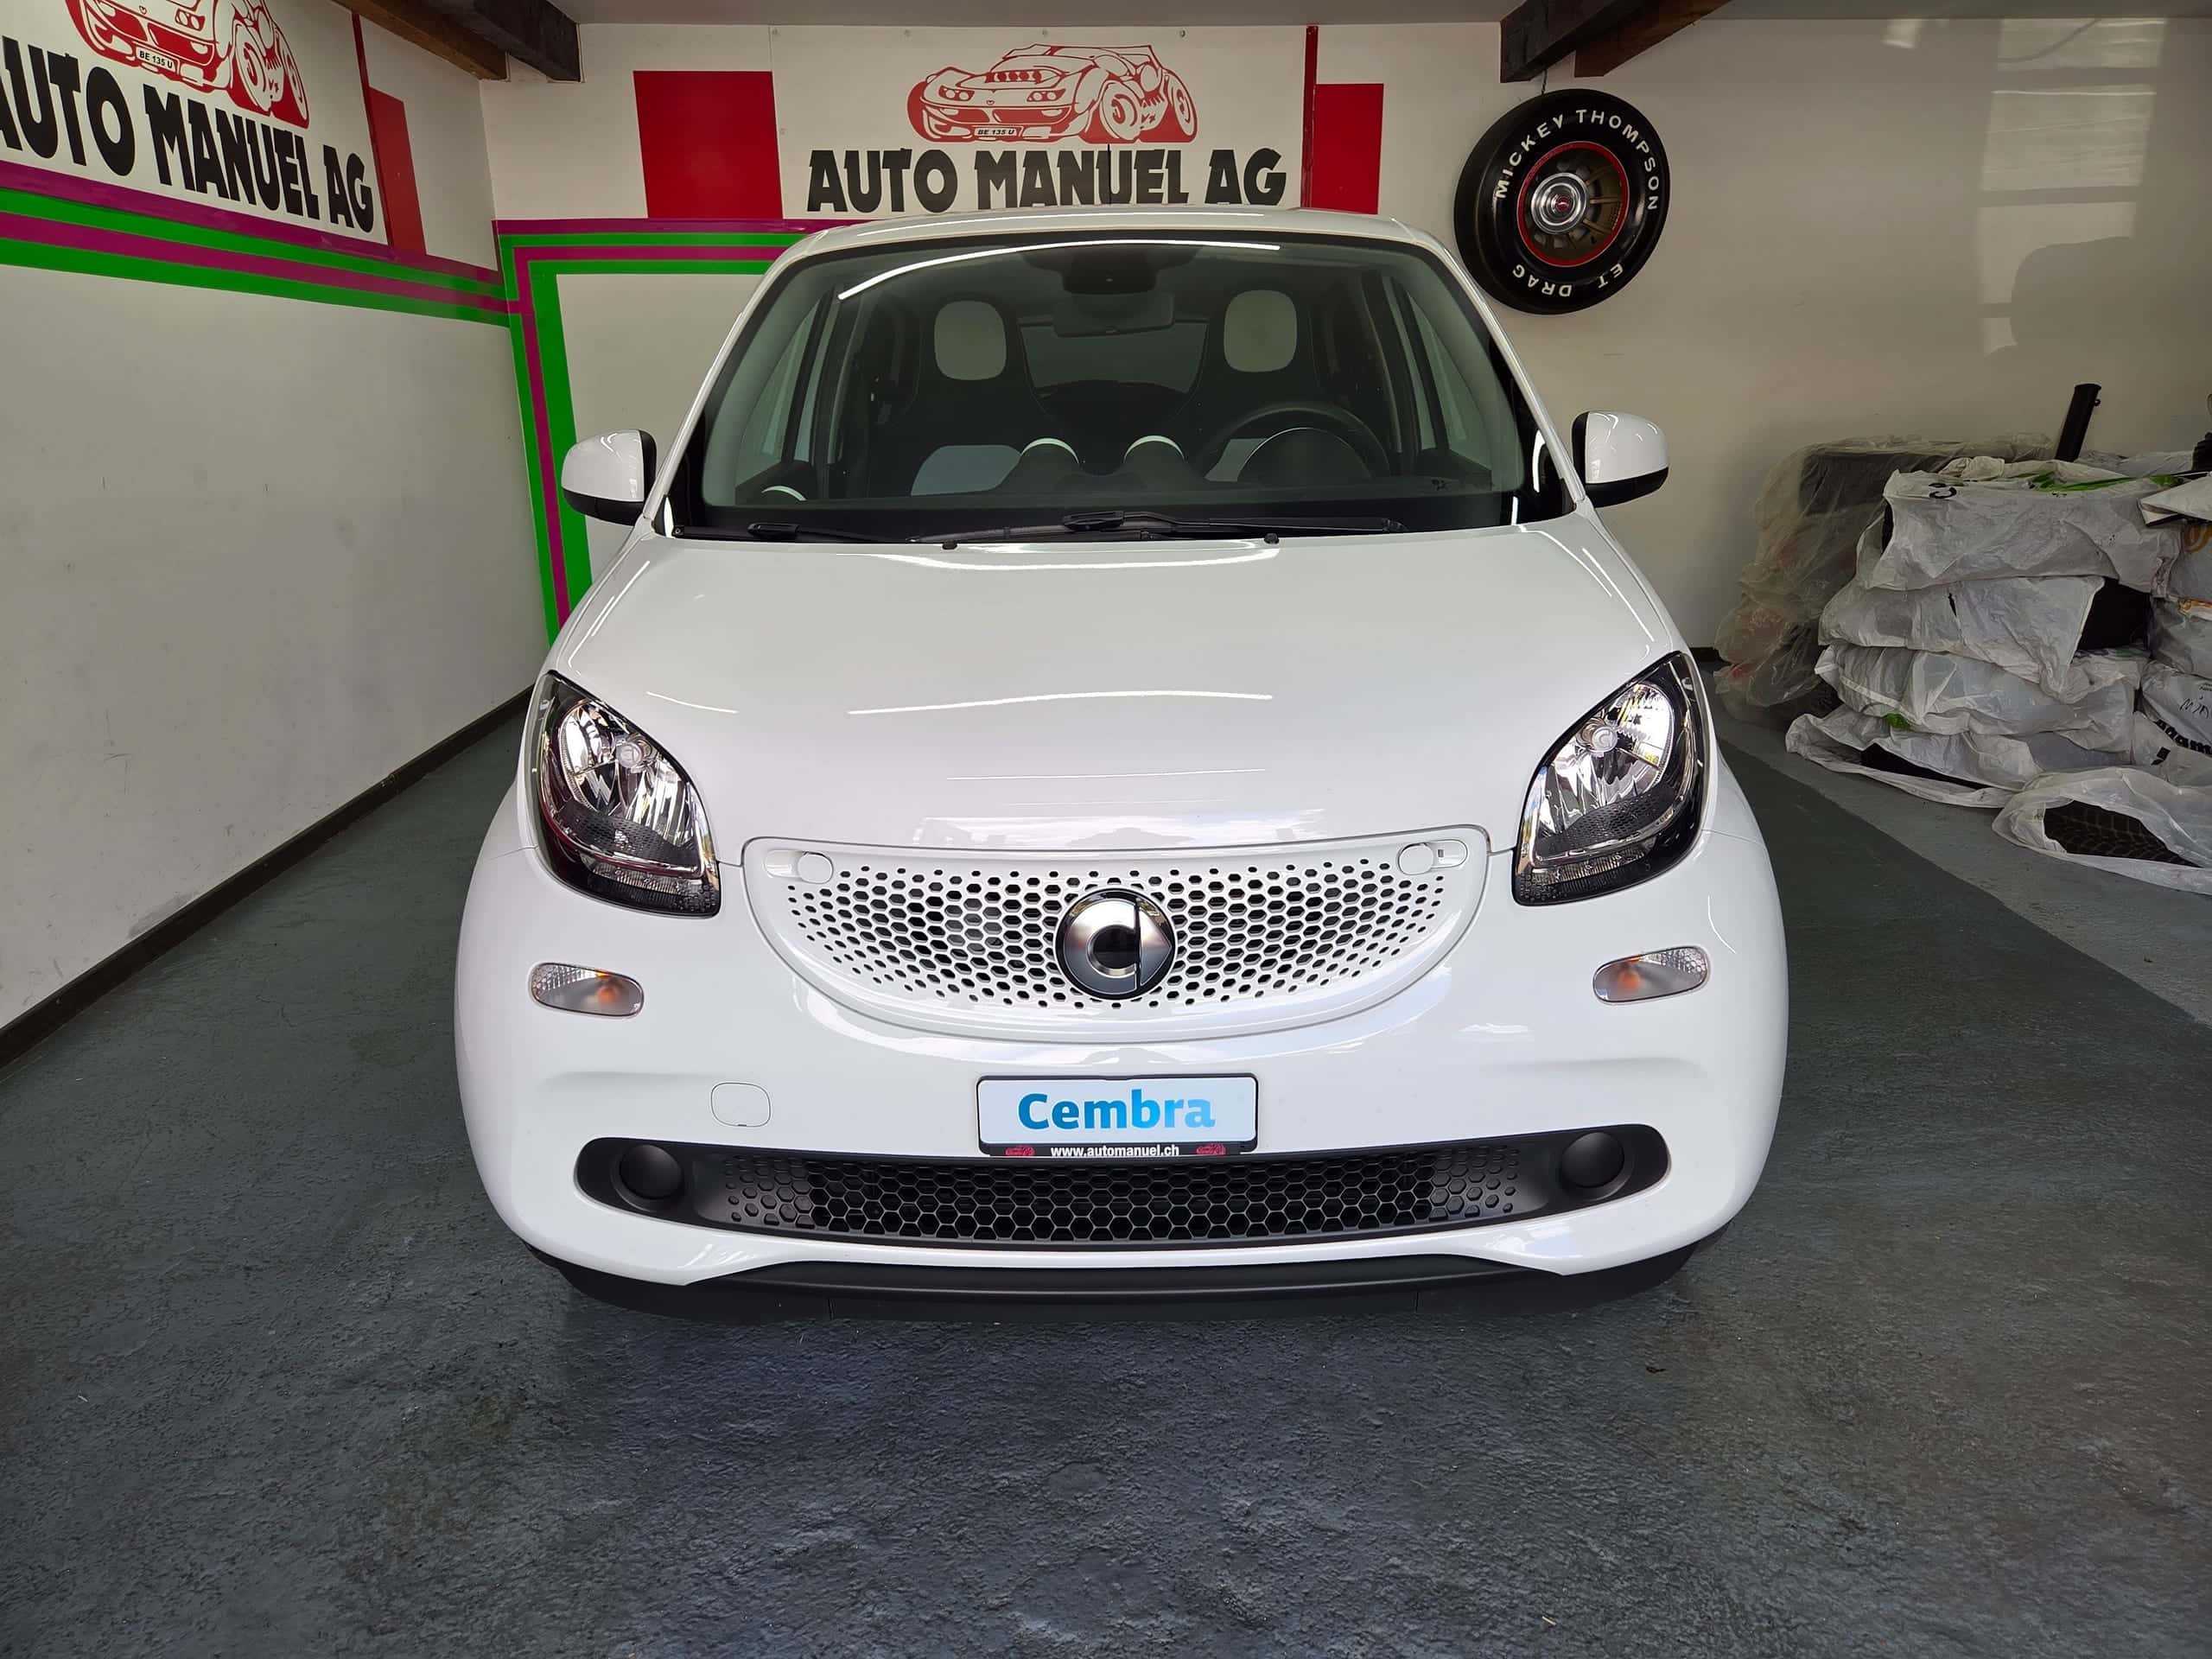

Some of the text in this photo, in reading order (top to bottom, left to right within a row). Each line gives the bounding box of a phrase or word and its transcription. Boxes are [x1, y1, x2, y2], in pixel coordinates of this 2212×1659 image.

[143, 84, 320, 219] MANUEL
[323, 144, 374, 232] AG
[806, 148, 1287, 213] AUTO MANUEL AG
[1495, 109, 1660, 210] MICKEY THOMPSON
[1512, 263, 1624, 297] ET DRAG
[1018, 1089, 1216, 1130] Cembra
[1051, 1144, 1179, 1157] www.automanuel.ch
